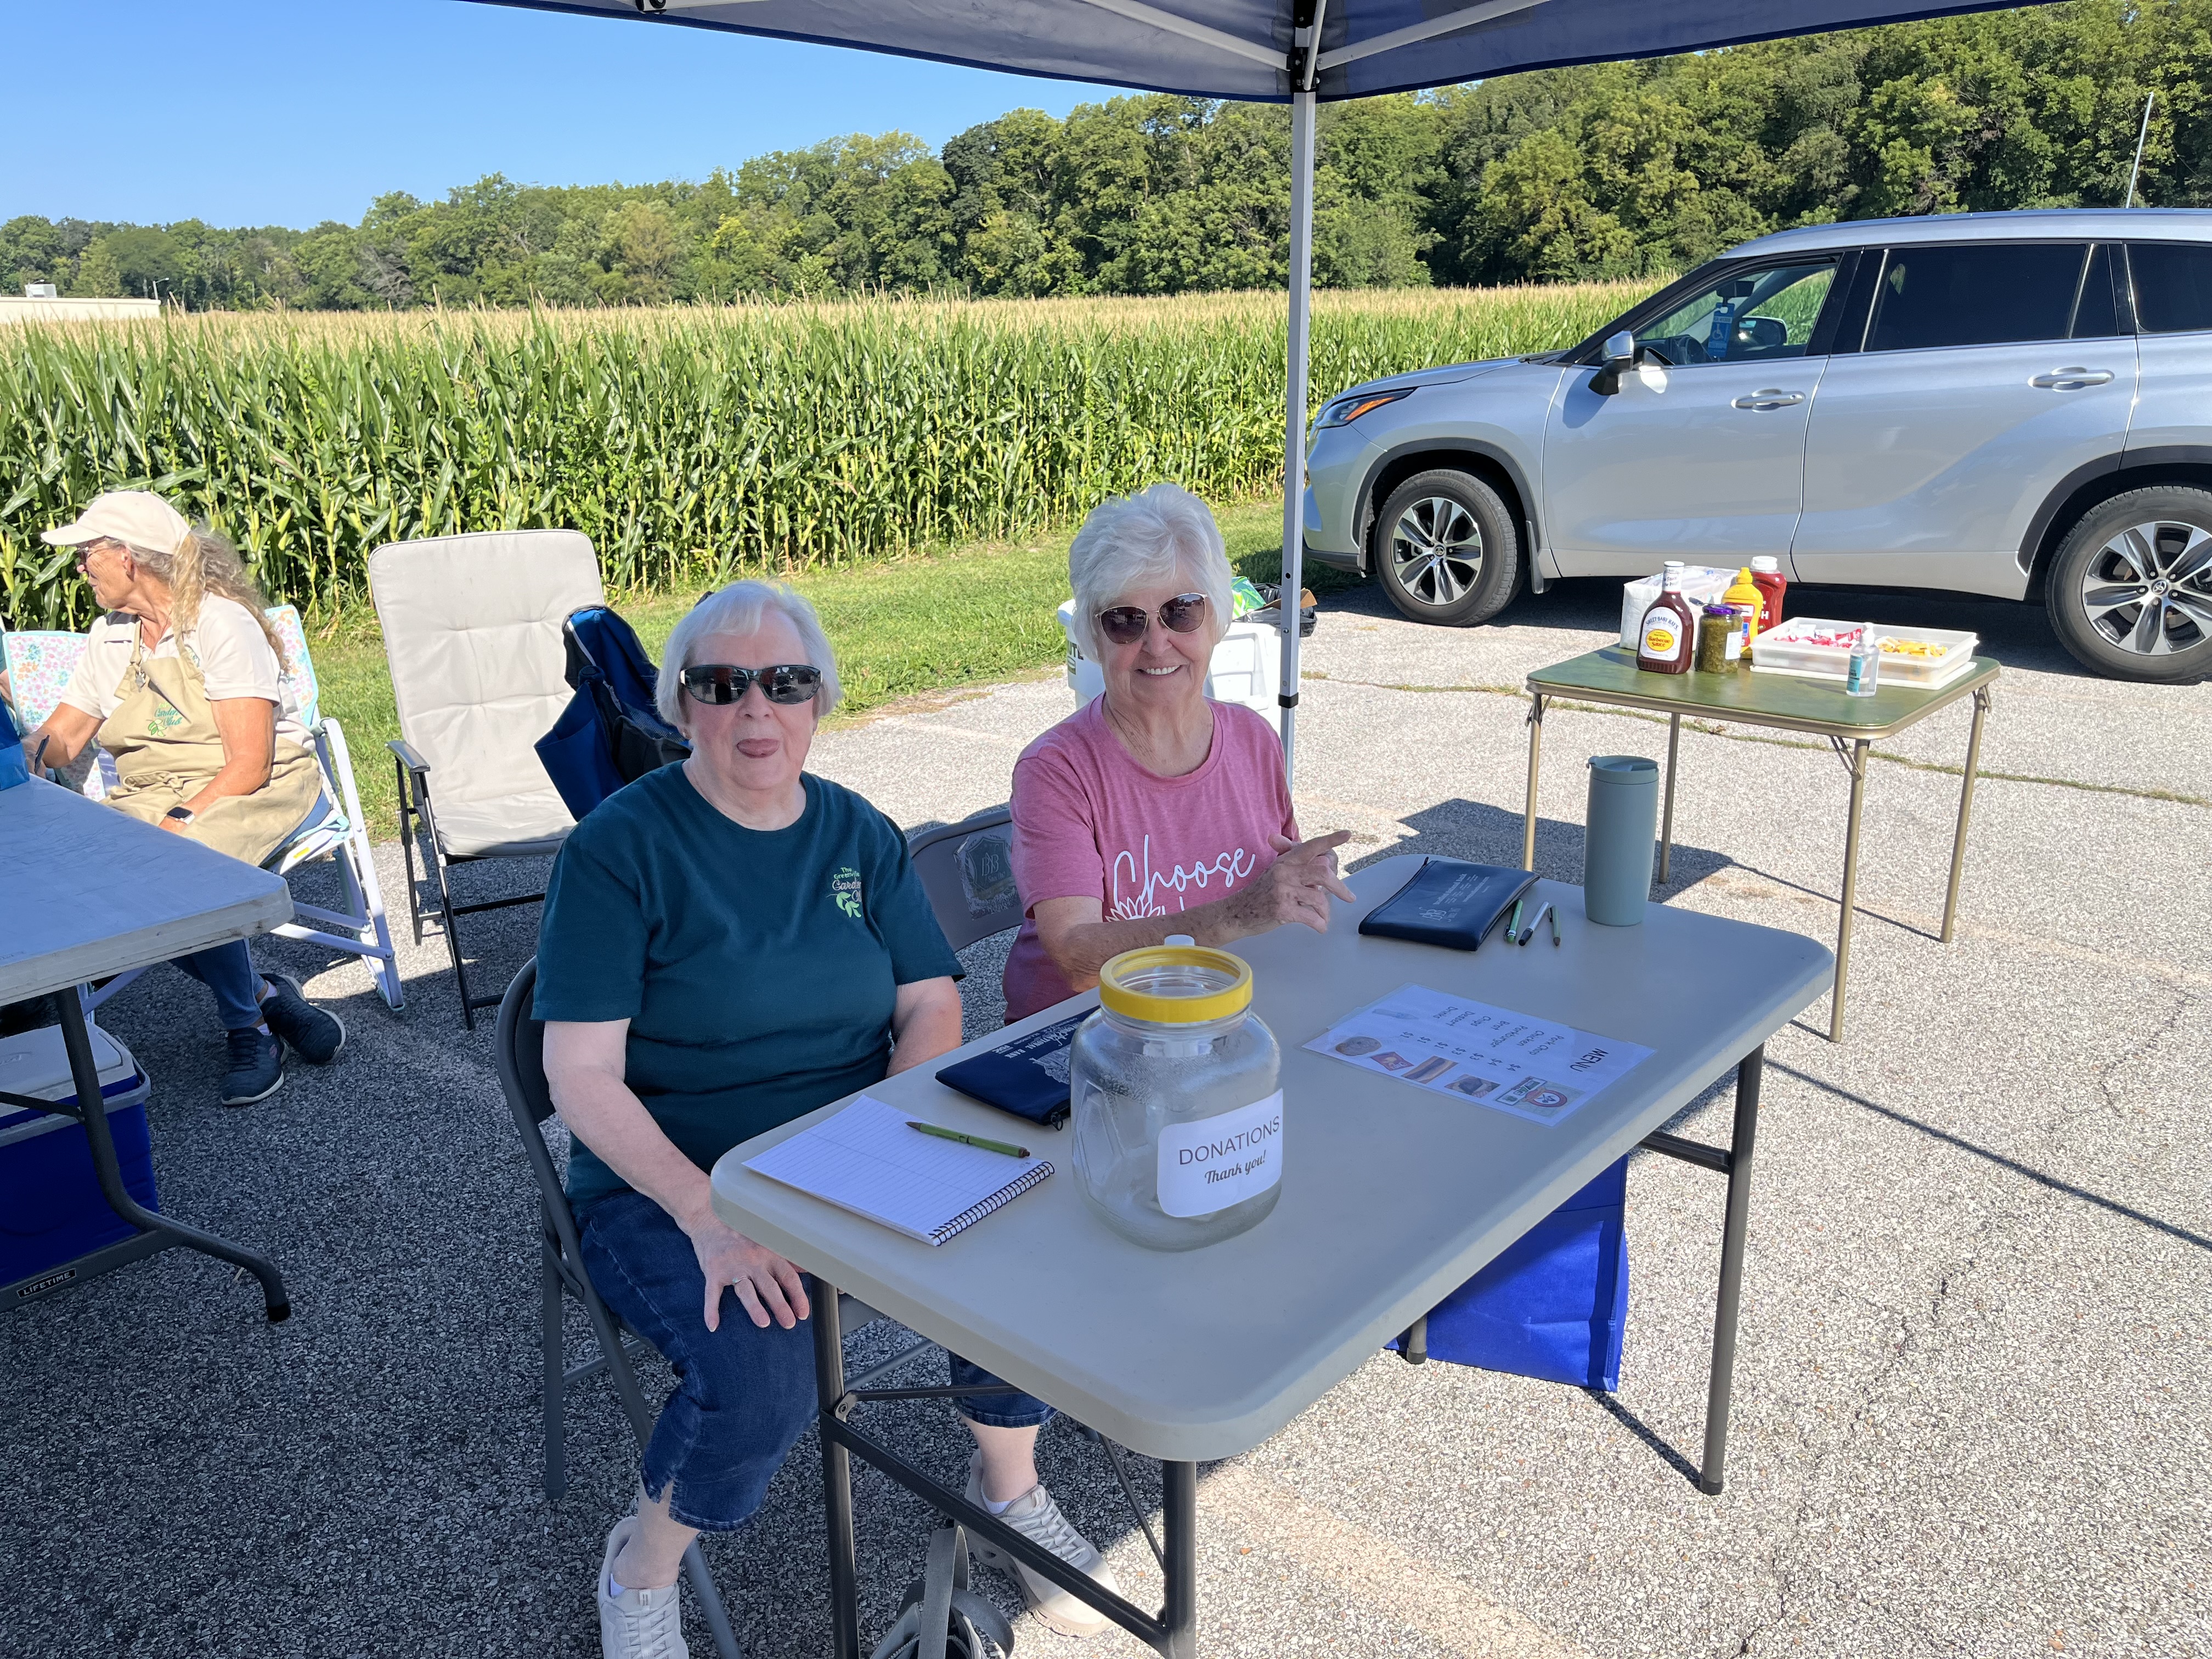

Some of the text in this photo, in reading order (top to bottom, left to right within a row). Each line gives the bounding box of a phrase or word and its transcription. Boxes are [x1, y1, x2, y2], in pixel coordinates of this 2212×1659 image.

[1113, 833, 1256, 911] Choose
[1432, 1006, 1459, 1019] Drinks
[1446, 1011, 1475, 1026] Dessert
[1470, 1015, 1492, 1026] Chips
[1491, 1019, 1510, 1030] Brat
[1004, 1048, 1026, 1059] BANK
[1469, 1025, 1528, 1060] Porkburger $3
[1487, 1030, 1544, 1066] Chicken $4
[1506, 1035, 1565, 1071] Pork Chop $4
[1570, 1048, 1609, 1072] MENU
[1179, 1115, 1279, 1165] DONATIONS
[1204, 1149, 1266, 1184] Thank you!
[23, 1271, 71, 1295] LIFETIME
